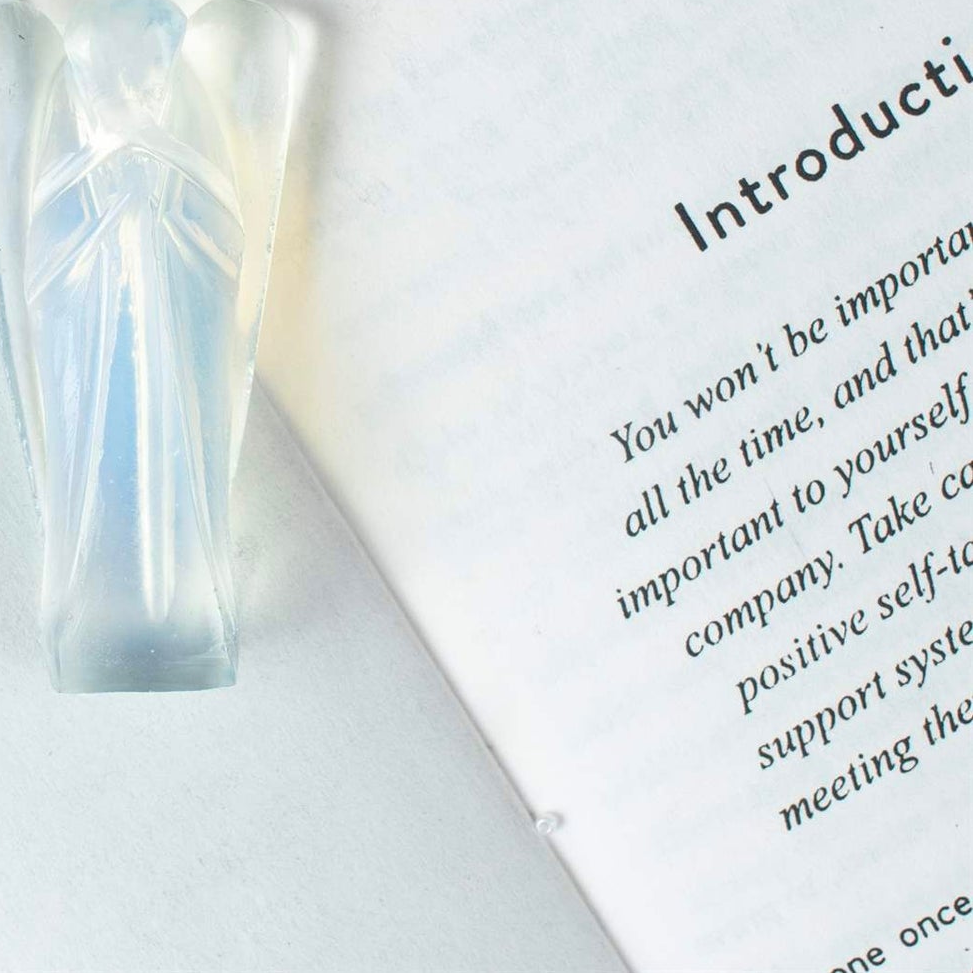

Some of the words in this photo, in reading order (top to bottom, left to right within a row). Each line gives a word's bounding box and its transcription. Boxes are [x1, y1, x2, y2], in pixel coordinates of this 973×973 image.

[673, 35, 973, 253] Introducti
[609, 410, 679, 464] You
[683, 342, 780, 420] won't
[781, 317, 829, 358] be
[625, 483, 671, 538] all
[676, 457, 732, 506] the
[739, 405, 825, 468] time,
[833, 340, 898, 410] and
[615, 498, 785, 620] important
[791, 479, 826, 514] to
[832, 371, 970, 500] yourself
[685, 549, 844, 658] company.
[847, 491, 932, 555] Take
[735, 609, 869, 716] positive
[757, 671, 887, 771] support
[778, 735, 920, 832] meeting
[899, 895, 973, 948] once
